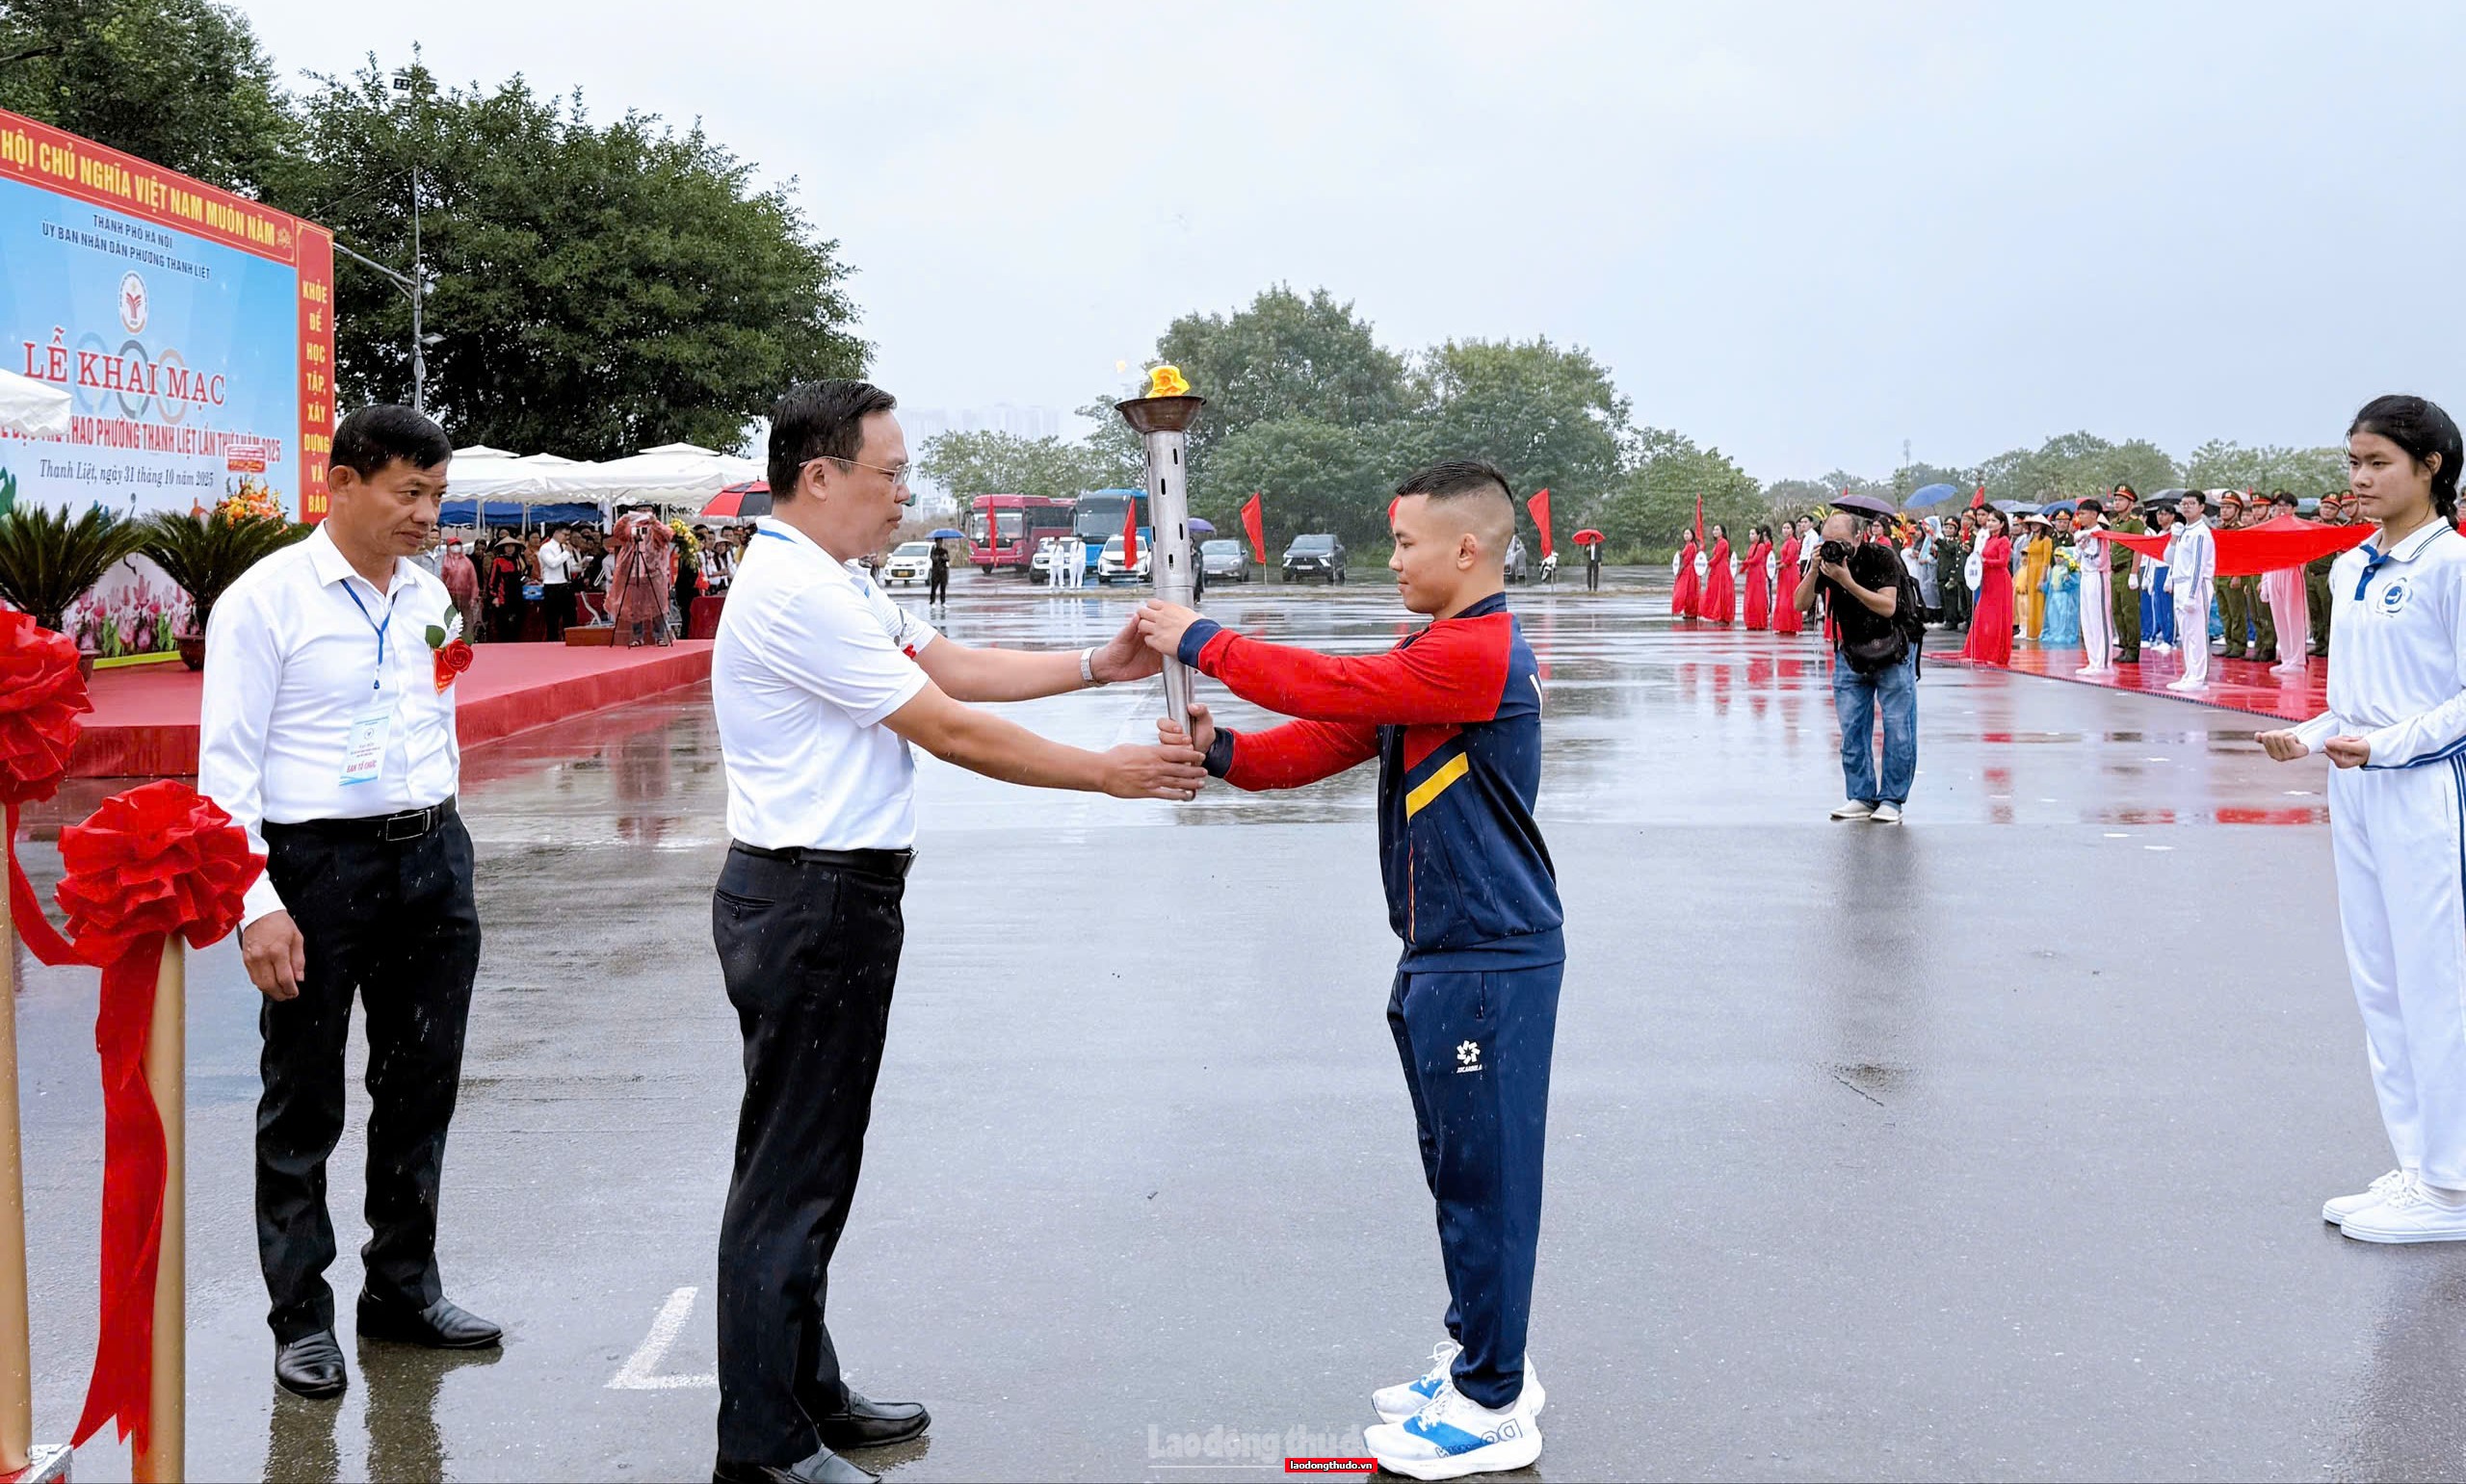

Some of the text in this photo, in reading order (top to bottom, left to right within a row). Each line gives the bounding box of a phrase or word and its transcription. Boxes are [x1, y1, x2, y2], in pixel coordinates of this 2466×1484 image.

[2, 128, 275, 247] HỘI CHỦ NGHĨA VIỆT NAM MUÔN NĂM
[58, 226, 78, 244] BAN
[81, 232, 107, 251] NHÂN
[109, 240, 128, 257] DÂN
[167, 257, 193, 275] THANH
[306, 342, 326, 366] HỌC
[23, 325, 224, 410] LỄ KHAI MẠC
[307, 401, 326, 423] XÂY
[66, 415, 93, 445] HAO
[96, 414, 140, 450] PHƯỜNG
[143, 424, 174, 454] THANH
[177, 423, 197, 459] LIỆT
[303, 432, 330, 456] DỰNG
[40, 459, 73, 479] Thanh
[100, 464, 122, 485] ngày
[124, 465, 135, 482] 31
[137, 467, 162, 488] tháng
[175, 470, 194, 485] năm
[311, 461, 324, 482] VÀ
[308, 489, 327, 513] BẢO
